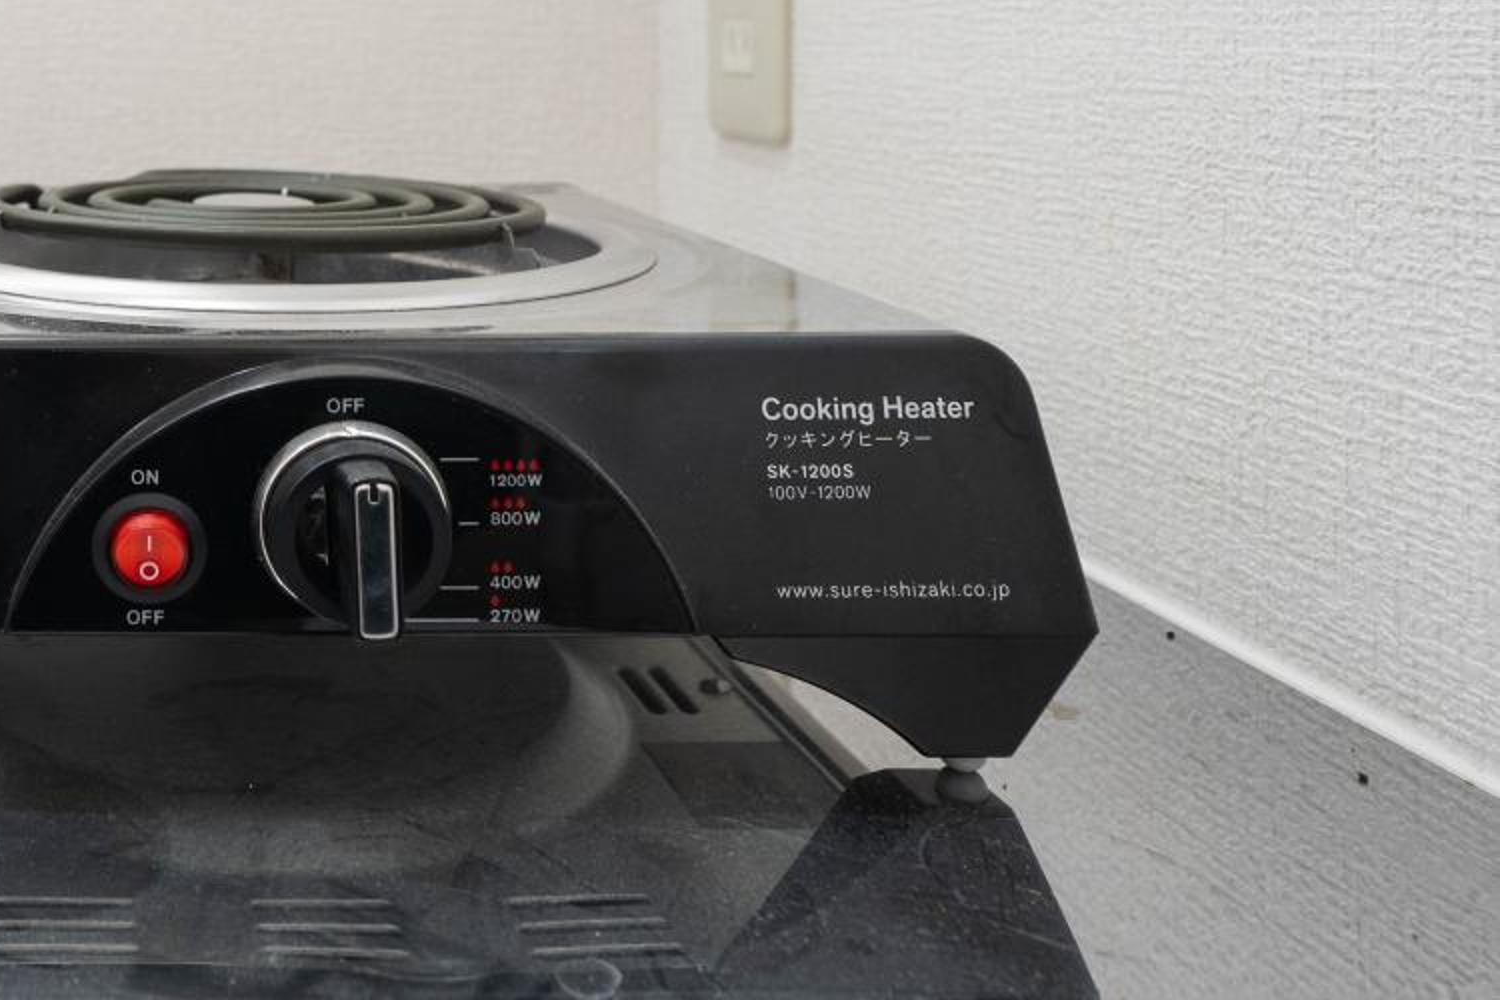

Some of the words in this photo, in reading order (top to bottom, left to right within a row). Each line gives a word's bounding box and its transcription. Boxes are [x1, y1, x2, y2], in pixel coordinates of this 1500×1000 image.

[326, 397, 365, 414] OFF
[761, 396, 875, 426] Cooking
[882, 395, 975, 419] Heater
[765, 429, 933, 449] クッキングヒーター
[131, 469, 160, 486] ON
[766, 463, 854, 480] SK-1200S
[489, 473, 543, 488] 1200W
[489, 511, 541, 526] 800W
[489, 575, 541, 590] 400W
[777, 580, 1010, 601] www.sure-ishizaki.co.jp
[126, 609, 165, 626] OFF
[489, 609, 541, 624] 270W
